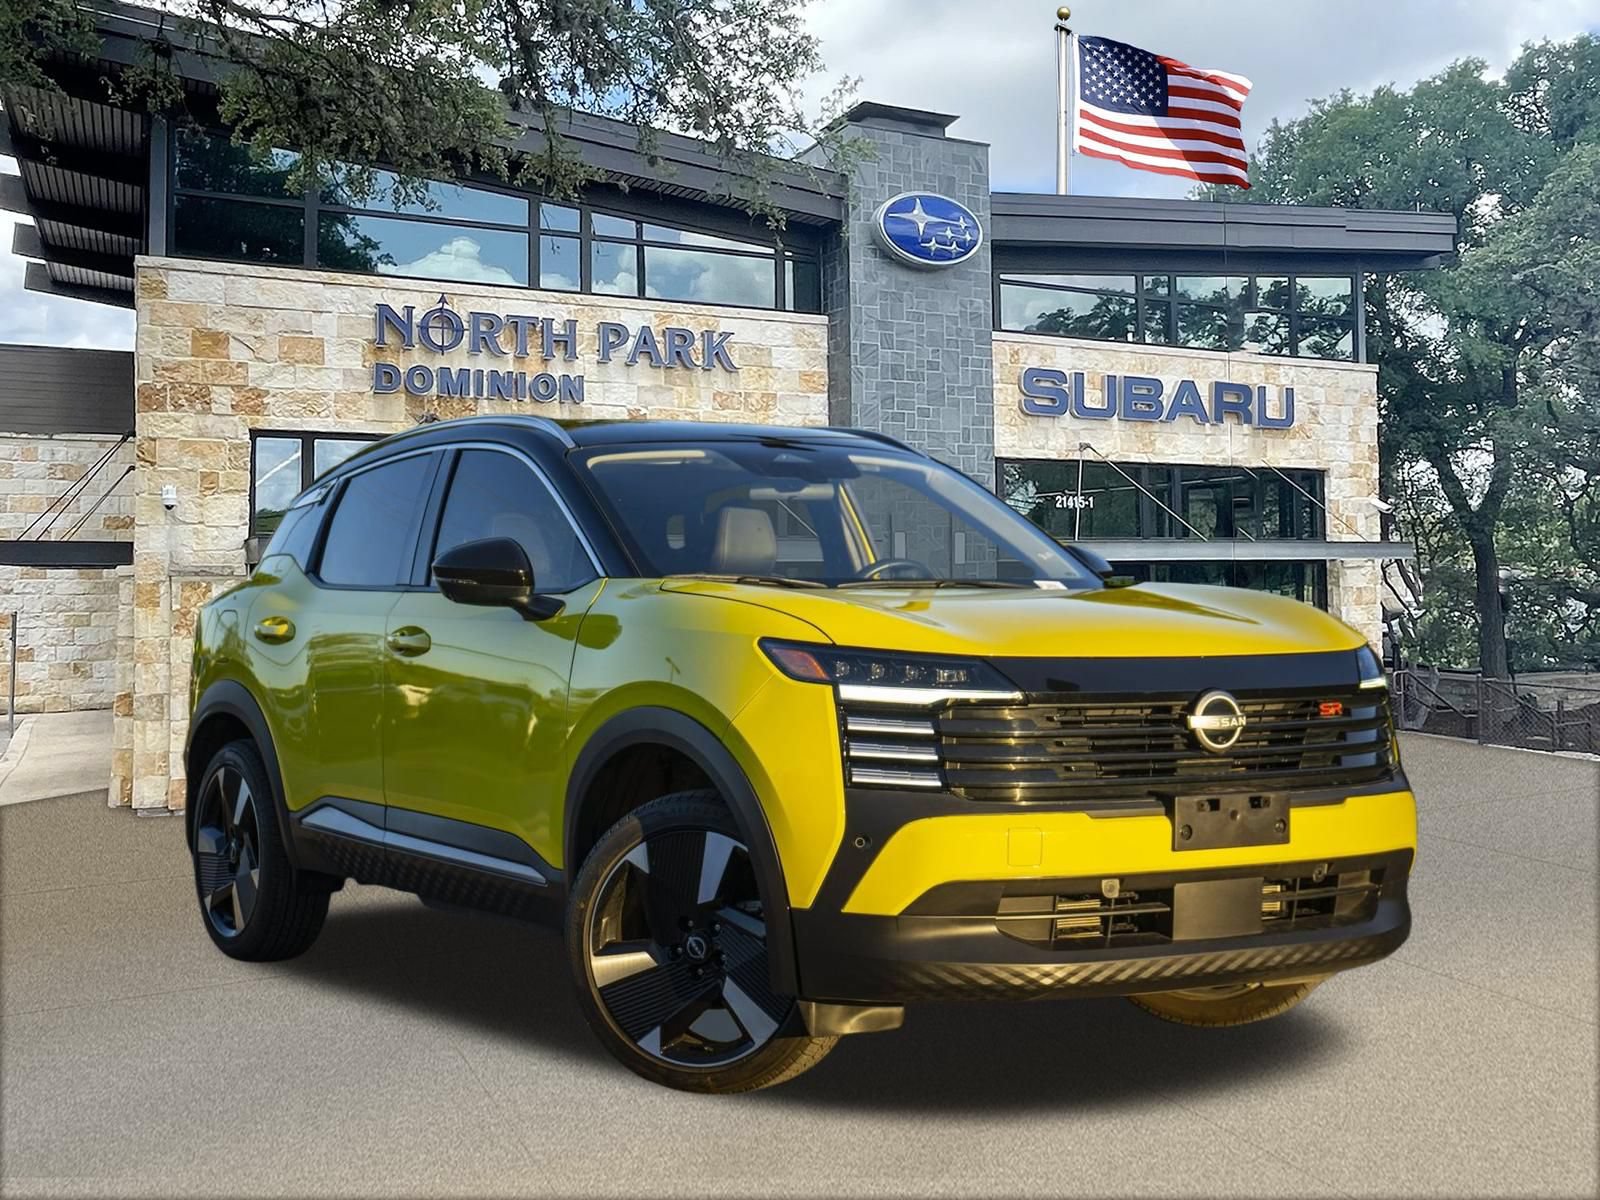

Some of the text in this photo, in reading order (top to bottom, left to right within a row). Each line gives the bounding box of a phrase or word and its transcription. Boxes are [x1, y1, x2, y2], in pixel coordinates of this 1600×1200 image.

[375, 299, 741, 373] NORTH PARK
[372, 362, 585, 404] DOMINION
[1019, 367, 1295, 430] SUBARU
[1055, 495, 1094, 509] 21415-1
[1191, 715, 1247, 729] SSAN
[1319, 702, 1343, 717] SR
